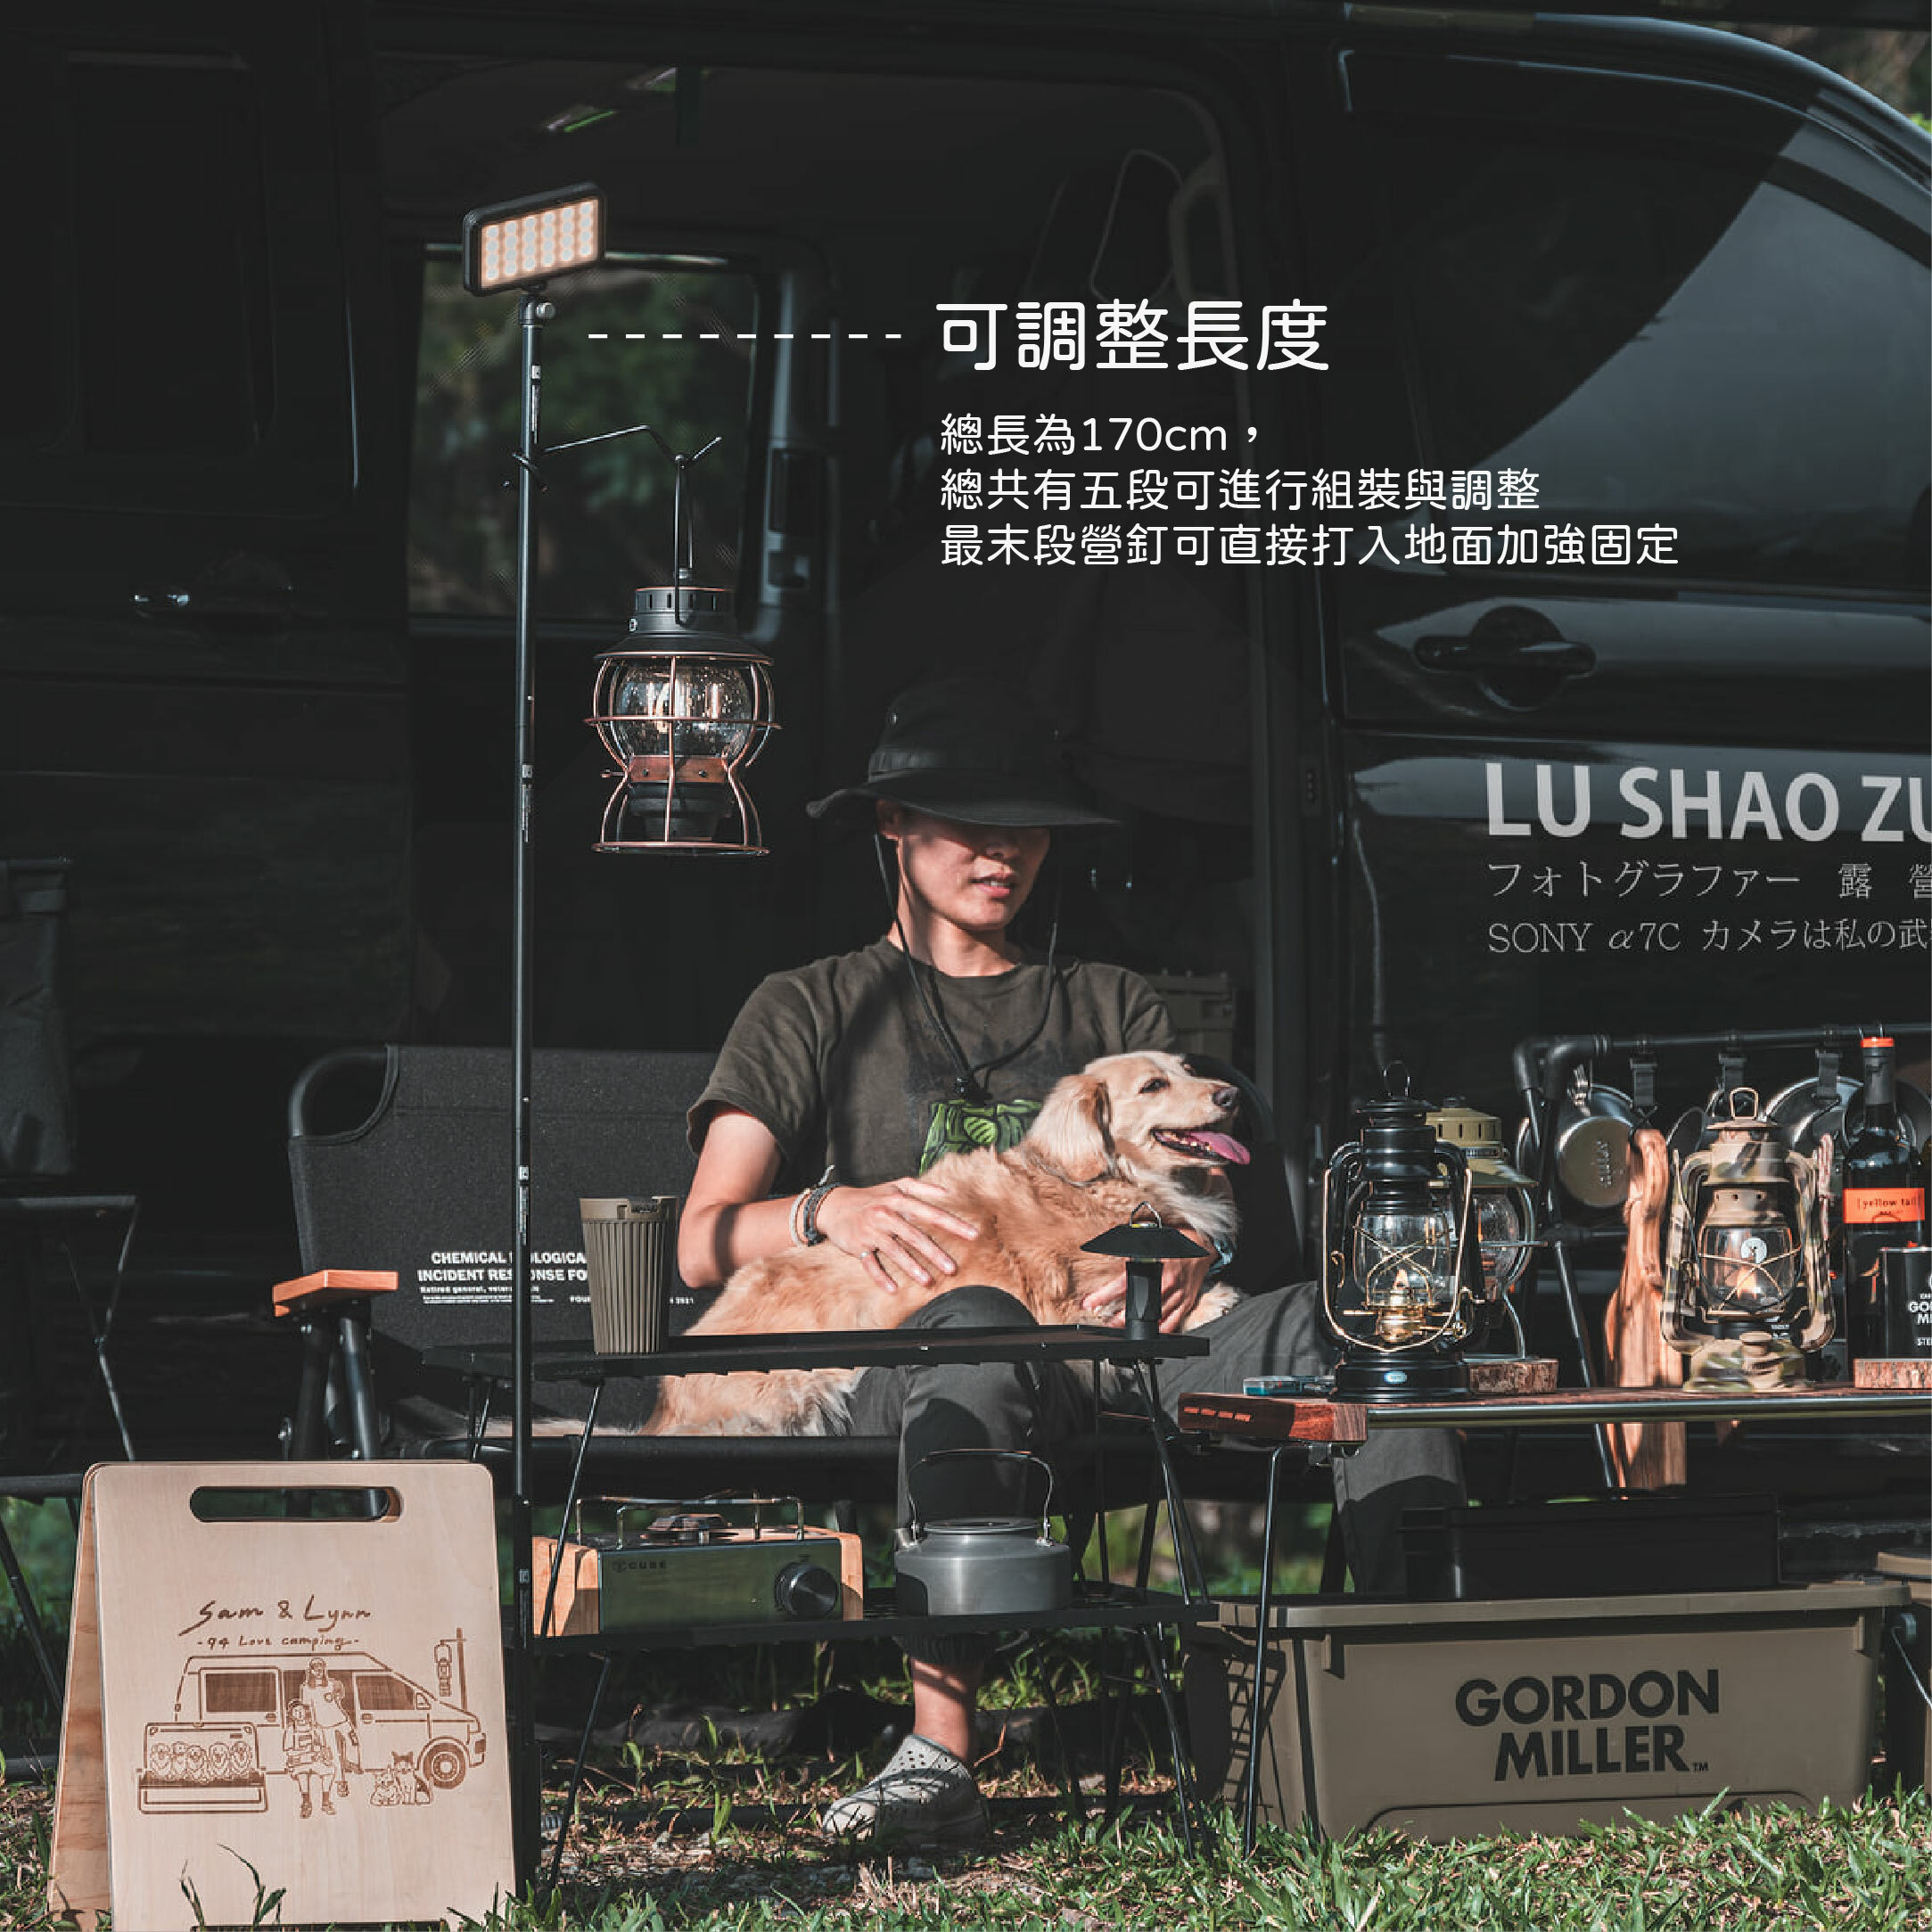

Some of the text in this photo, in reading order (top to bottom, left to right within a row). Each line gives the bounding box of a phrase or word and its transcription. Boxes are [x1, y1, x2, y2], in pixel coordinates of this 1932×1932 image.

[1486, 762, 1591, 838] LU
[1619, 767, 1839, 842] SHAO
[1488, 859, 1800, 897] フォトグラファー
[1488, 922, 1593, 953] SONY
[417, 1269, 485, 1282] INCIDENT
[431, 1251, 588, 1264] CHEMICAL LOGICA
[178, 1593, 372, 1638] Sam & Lynn
[1455, 1669, 1720, 1727] GORDON
[1494, 1723, 1690, 1781] MILLER
